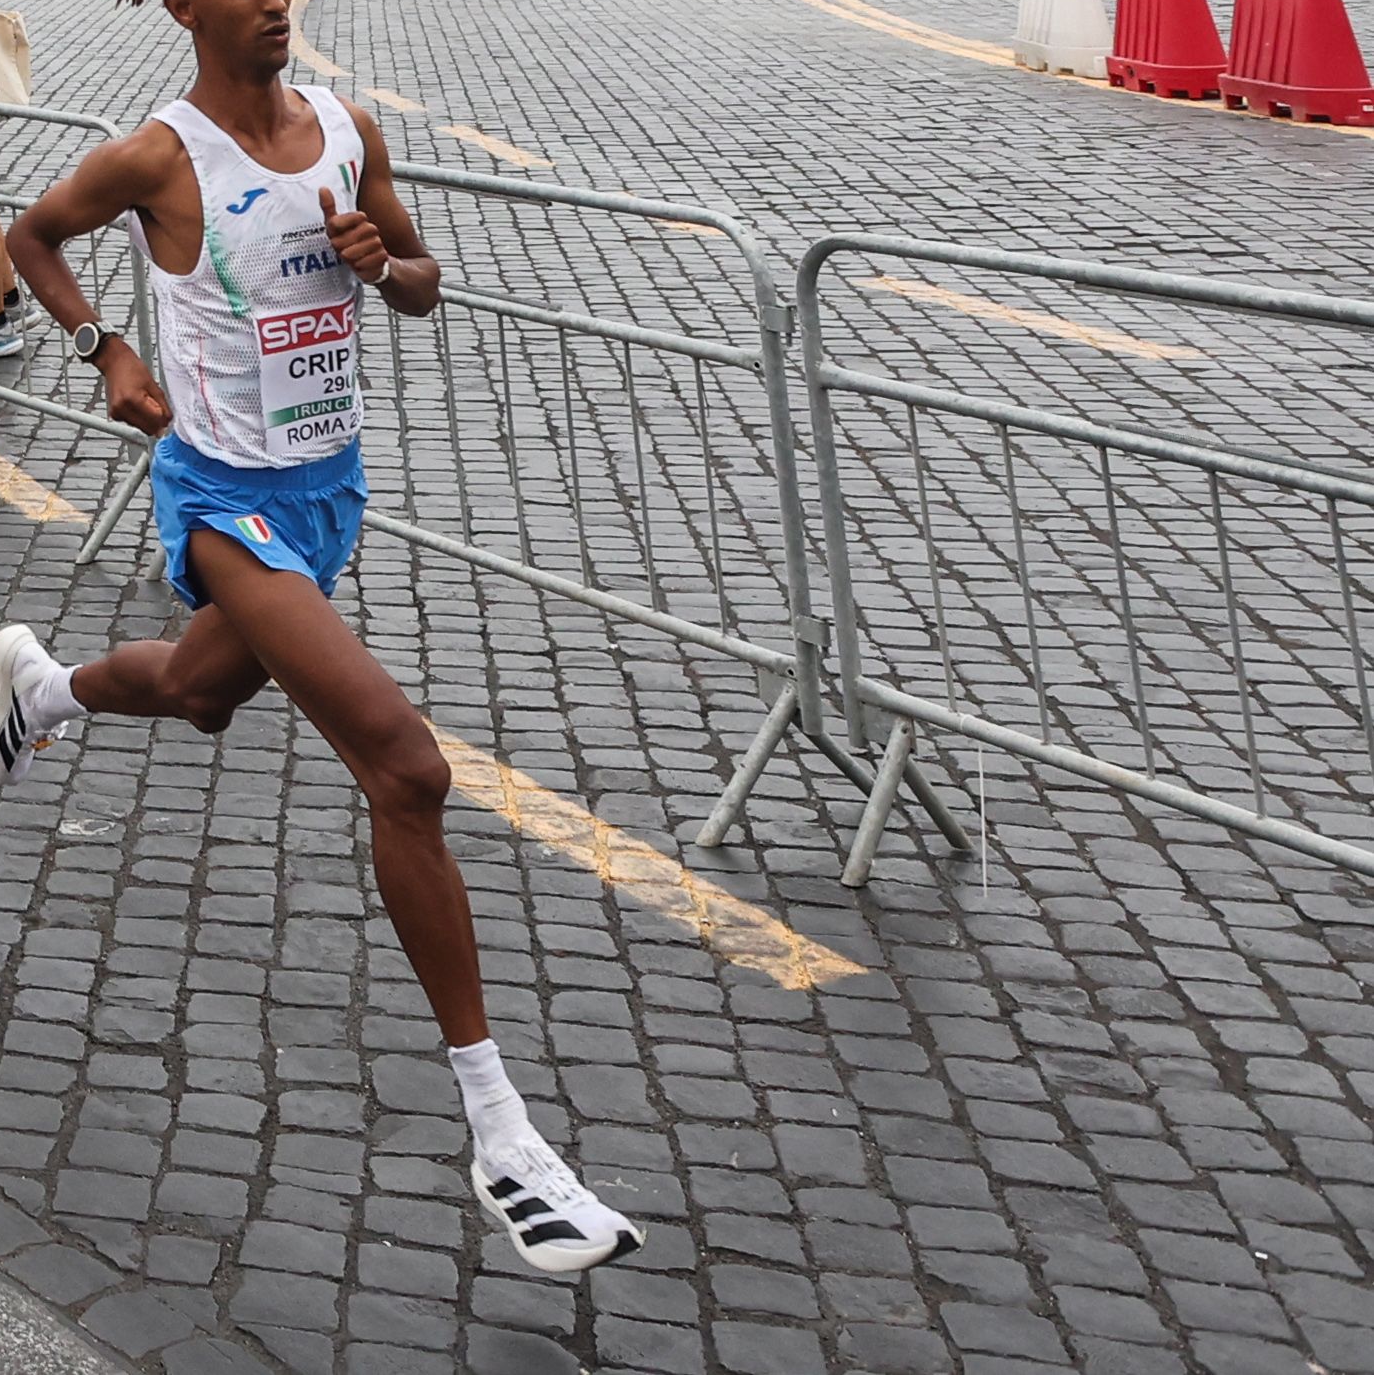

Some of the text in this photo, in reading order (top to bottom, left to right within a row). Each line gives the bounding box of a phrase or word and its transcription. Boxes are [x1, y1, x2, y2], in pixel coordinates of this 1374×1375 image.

[289, 348, 350, 380] CRIP
[294, 406, 300, 419] I
[301, 401, 334, 417] RUN
[287, 417, 346, 446] ROMA
